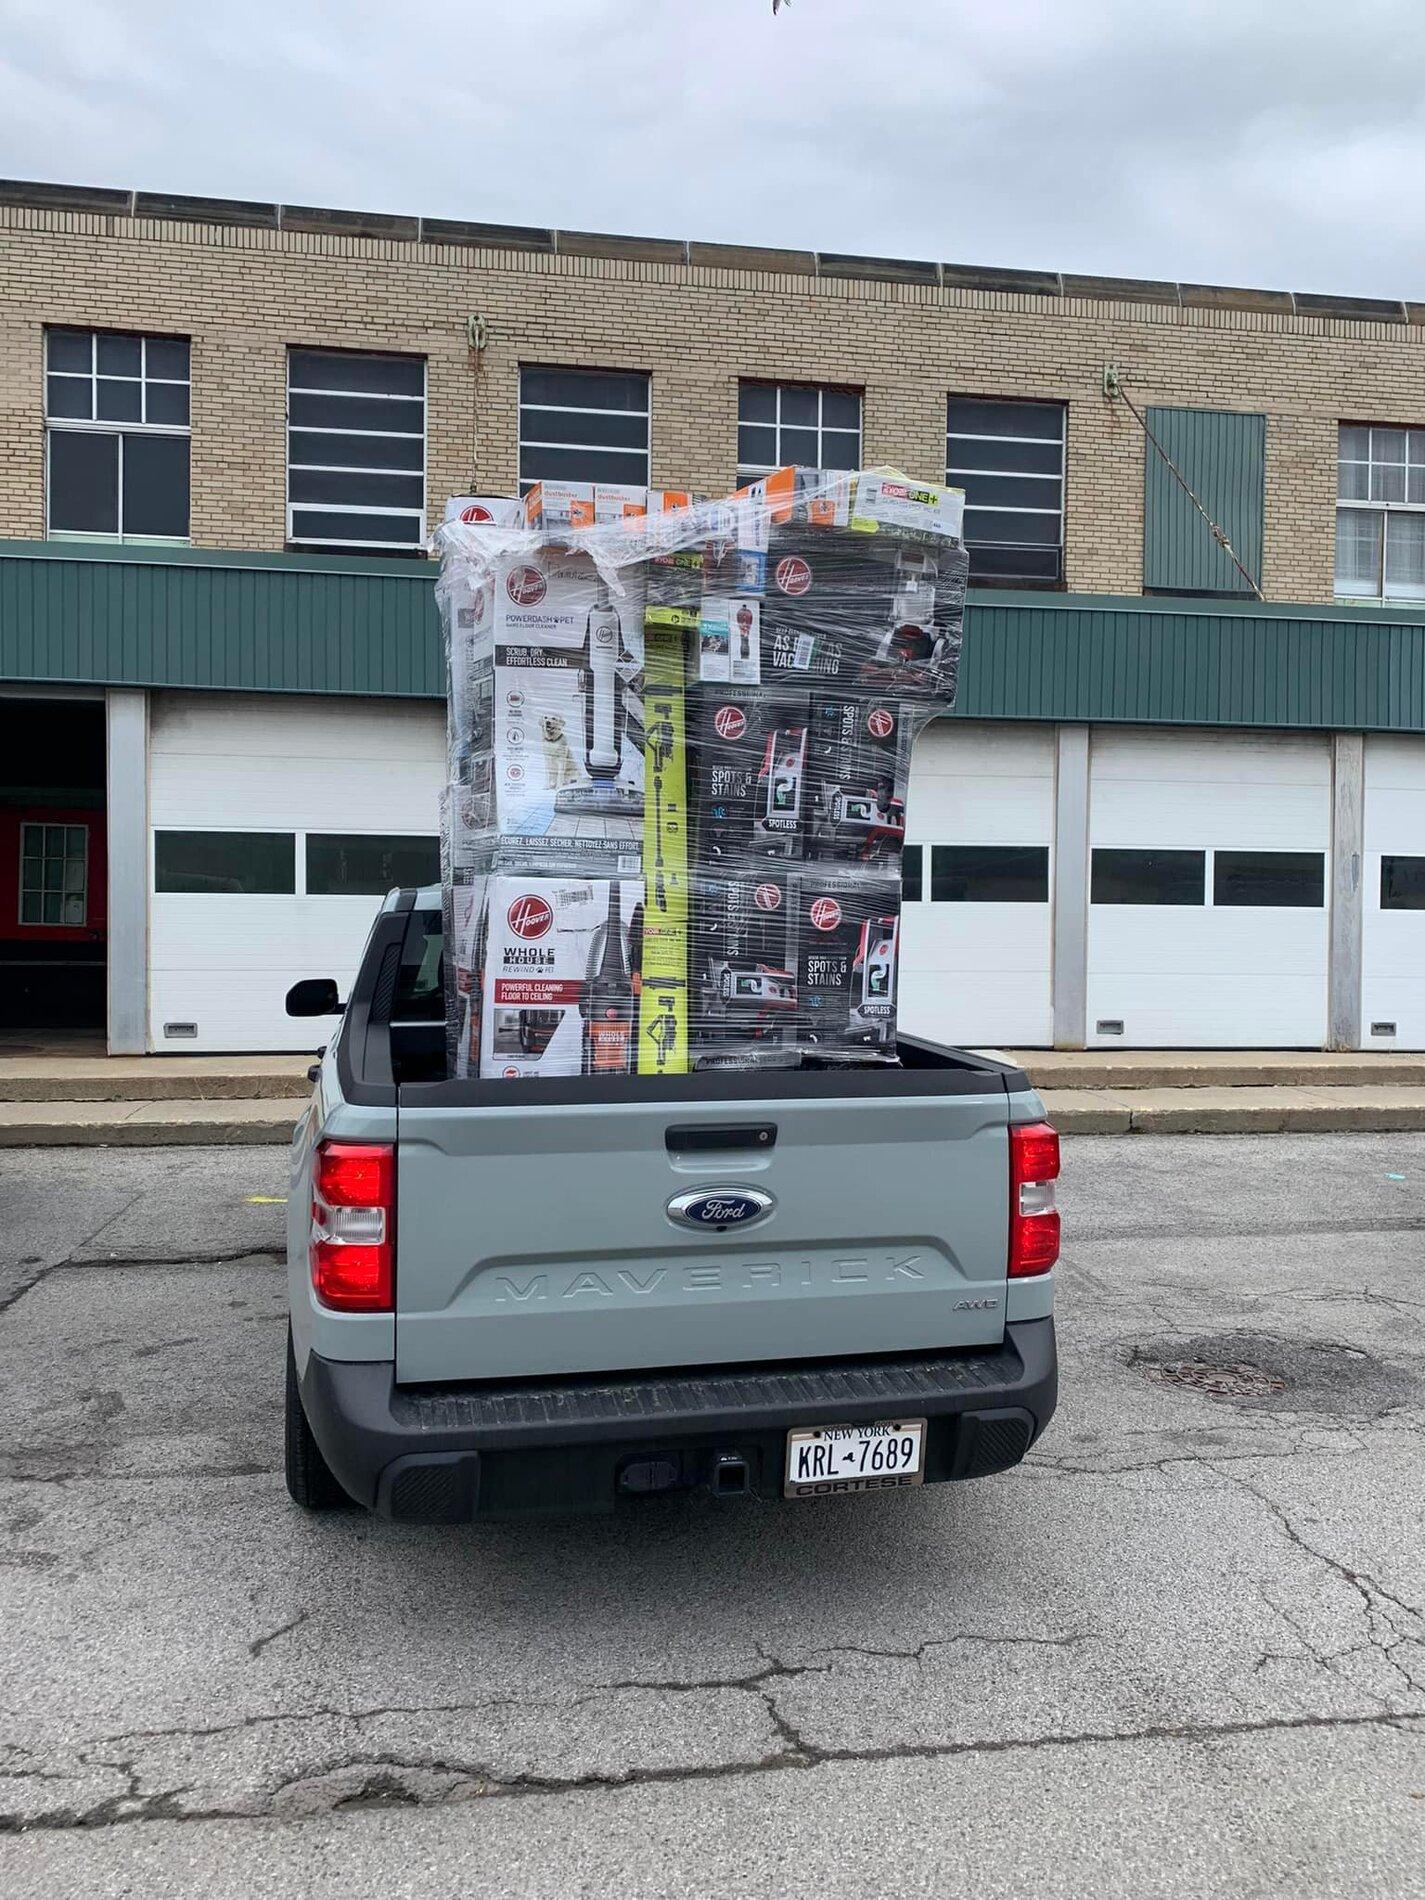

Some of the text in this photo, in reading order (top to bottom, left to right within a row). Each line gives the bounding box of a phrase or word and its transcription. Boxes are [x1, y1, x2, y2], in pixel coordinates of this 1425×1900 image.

[908, 491, 938, 505] ONE+
[506, 614, 575, 624] POWERDASH PET
[774, 635, 790, 651] AS
[506, 657, 545, 666] EFFORTLESS
[842, 706, 854, 735] SPOTS
[712, 771, 742, 784] SPOTS
[711, 783, 746, 796] STAINS
[769, 820, 796, 829] SPOTLESS
[727, 881, 739, 911] SPOTS
[511, 898, 550, 937] HOOVER
[504, 948, 555, 956] WHOLE
[508, 956, 549, 964] HOUSE
[808, 960, 847, 973] SPOTS &
[807, 973, 842, 986] STAINS
[501, 983, 563, 993] POWERFUL CLEANING
[501, 992, 553, 1001] FLOOR TO CEILING
[863, 1006, 891, 1015] SPOTLESS
[702, 1200, 746, 1219] Ford
[496, 1256, 925, 1301] MAVERICK
[953, 1299, 998, 1311] AWD
[824, 1430, 851, 1441] NEW
[857, 1426, 891, 1438] YORK
[798, 1437, 914, 1478] KRL 7689
[796, 1476, 912, 1496] CORTESE
